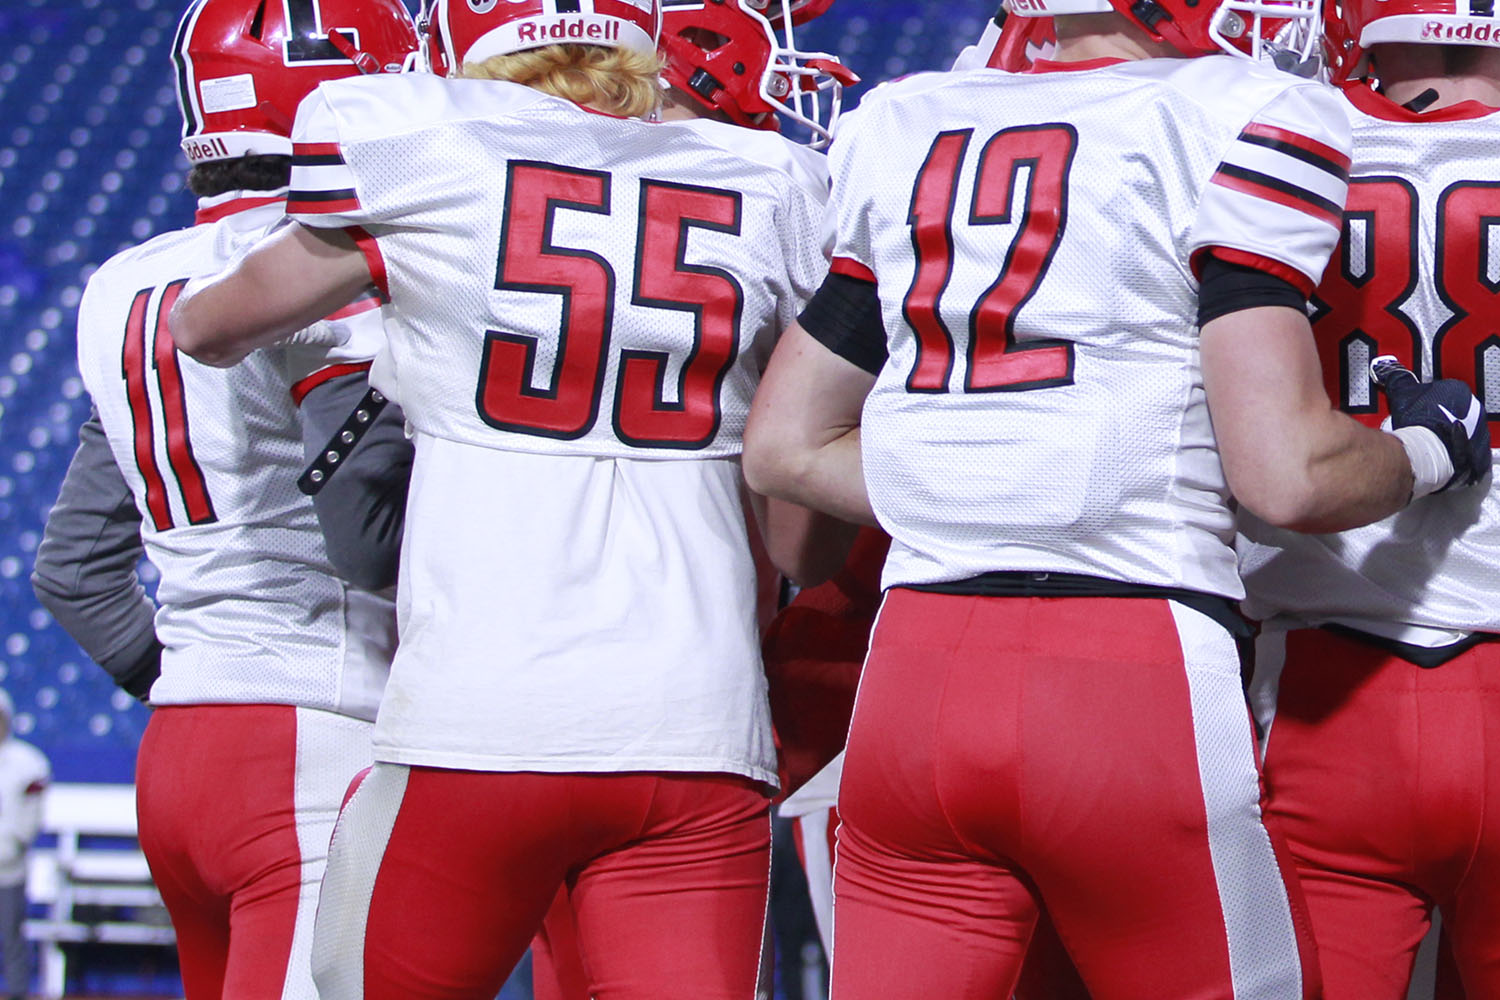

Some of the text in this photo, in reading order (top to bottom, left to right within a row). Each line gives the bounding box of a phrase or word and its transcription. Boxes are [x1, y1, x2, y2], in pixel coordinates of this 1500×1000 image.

[517, 19, 620, 43] Riddell
[476, 159, 744, 450] 55
[906, 122, 1077, 394] 12
[122, 278, 217, 533] 11
